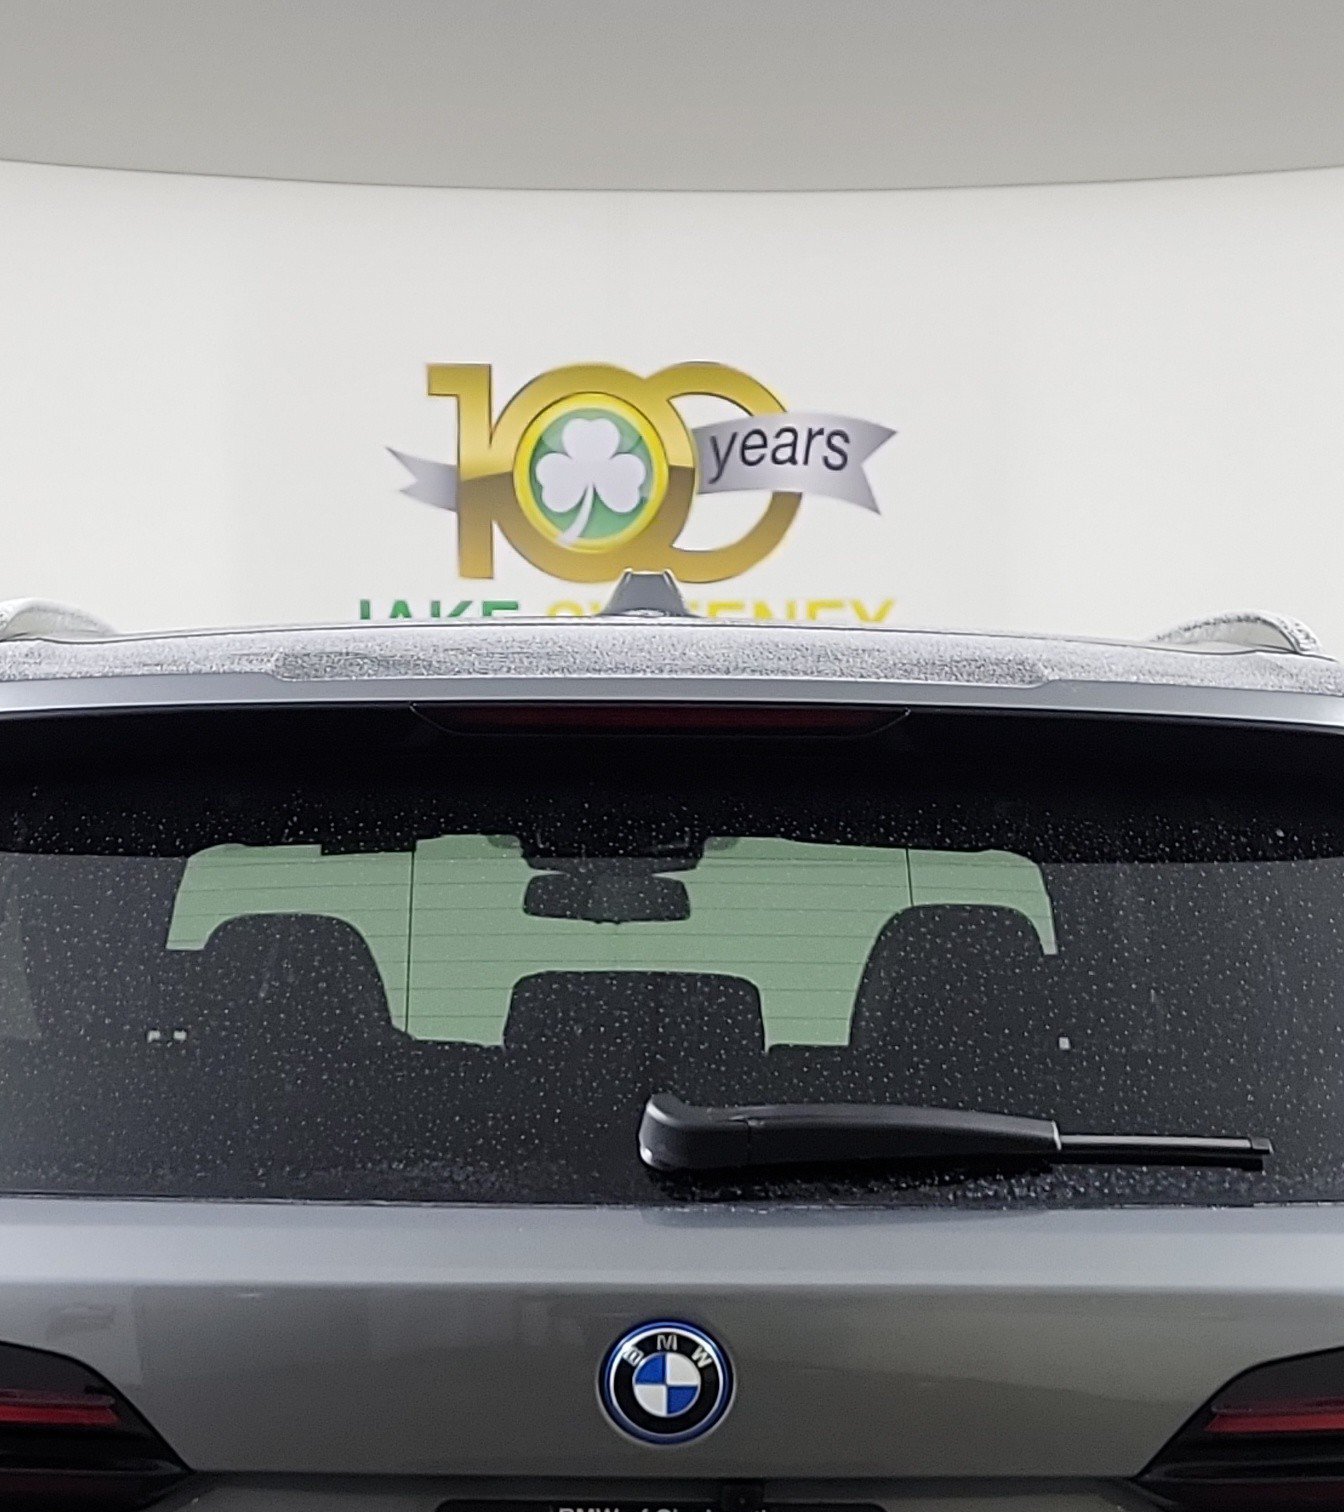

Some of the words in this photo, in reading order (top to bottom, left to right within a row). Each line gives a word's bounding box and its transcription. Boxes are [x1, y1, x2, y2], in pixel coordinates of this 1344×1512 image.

[426, 361, 804, 583] 100
[708, 424, 851, 484] years
[622, 1334, 713, 1368] BMW
